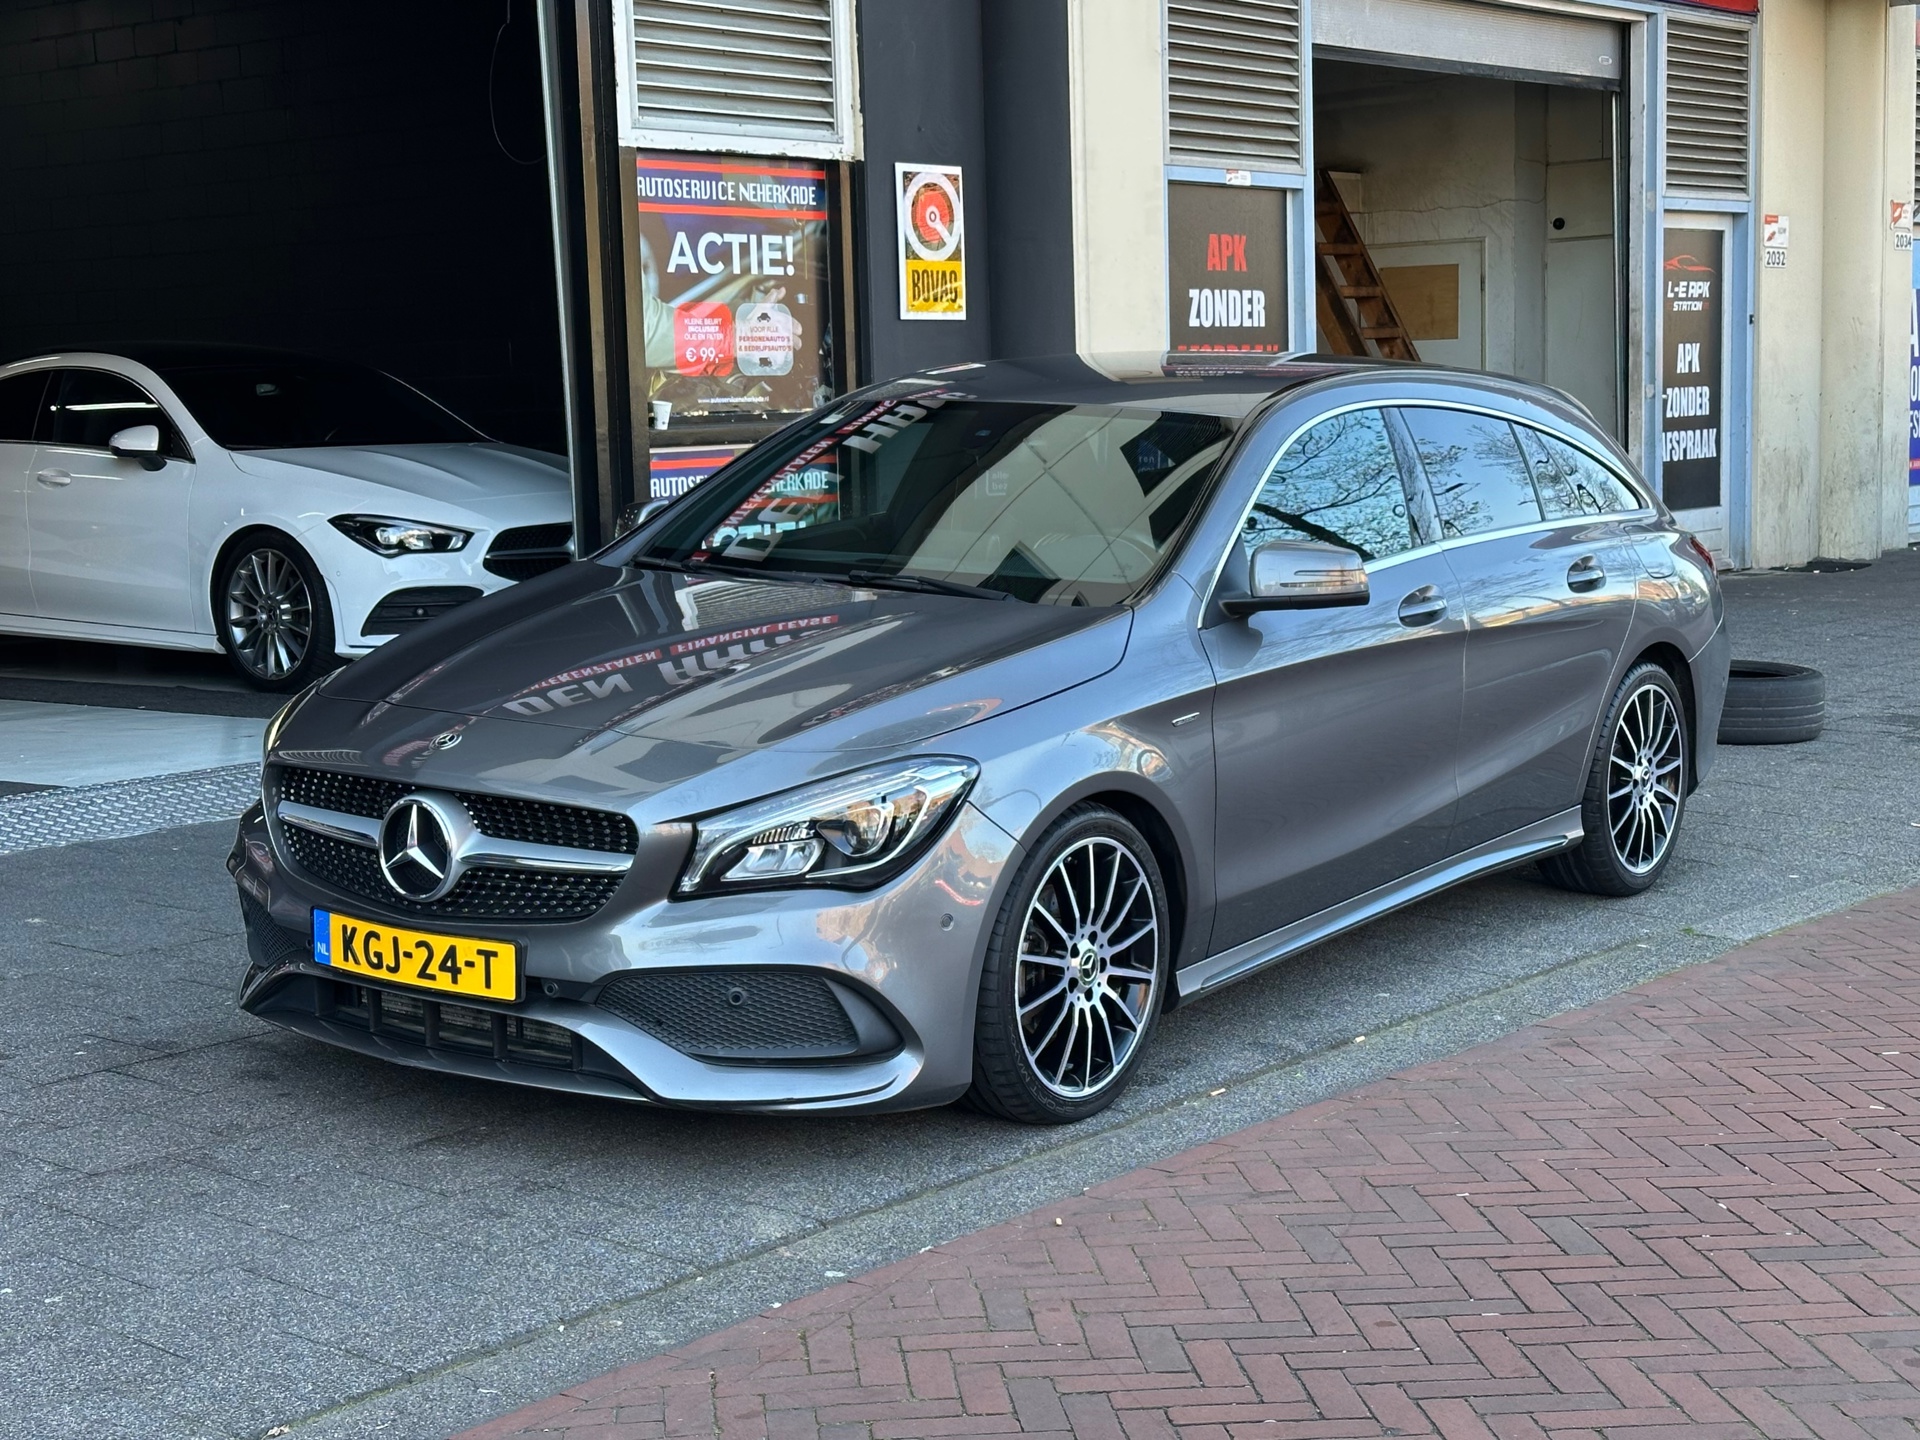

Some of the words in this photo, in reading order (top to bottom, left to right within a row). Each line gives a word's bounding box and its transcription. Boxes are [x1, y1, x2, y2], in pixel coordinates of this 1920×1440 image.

[637, 176, 736, 201] AUTOSERVICE
[739, 182, 817, 206] NEHERKADE
[666, 231, 795, 277] ACTIE!
[1207, 233, 1248, 272] APK
[1895, 234, 1912, 249] 2034
[1766, 250, 1787, 266] 2032
[1188, 288, 1266, 327] ZONDER
[1673, 301, 1703, 312] STATION
[699, 347, 724, 363] 99,-
[1676, 343, 1701, 374] APK
[1666, 385, 1710, 418] ZONDER
[317, 941, 329, 956] NL
[341, 923, 498, 990] KGJ-24-T
